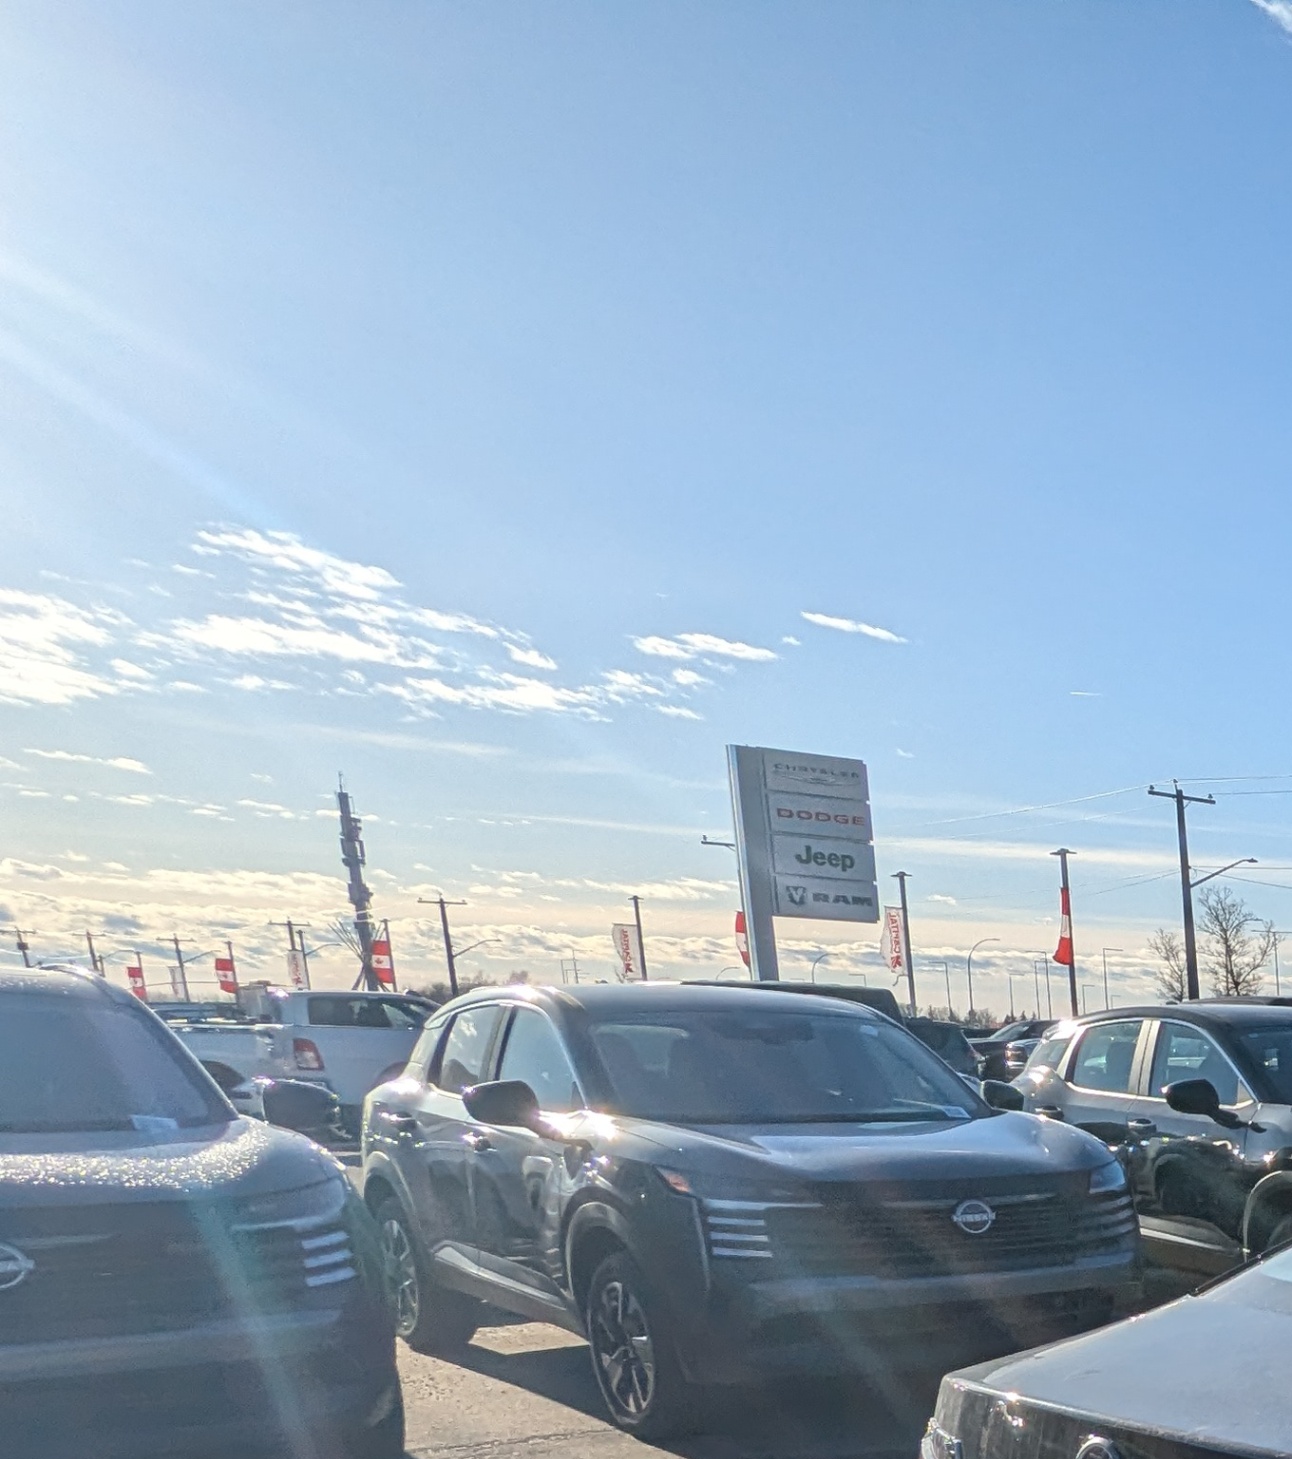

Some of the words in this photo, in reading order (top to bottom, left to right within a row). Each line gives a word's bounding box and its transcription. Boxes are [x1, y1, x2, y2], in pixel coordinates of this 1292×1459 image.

[773, 763, 859, 778] CHRYSLER
[777, 808, 865, 826] DODGE
[795, 845, 855, 872] Jeep
[812, 892, 873, 907] RAM
